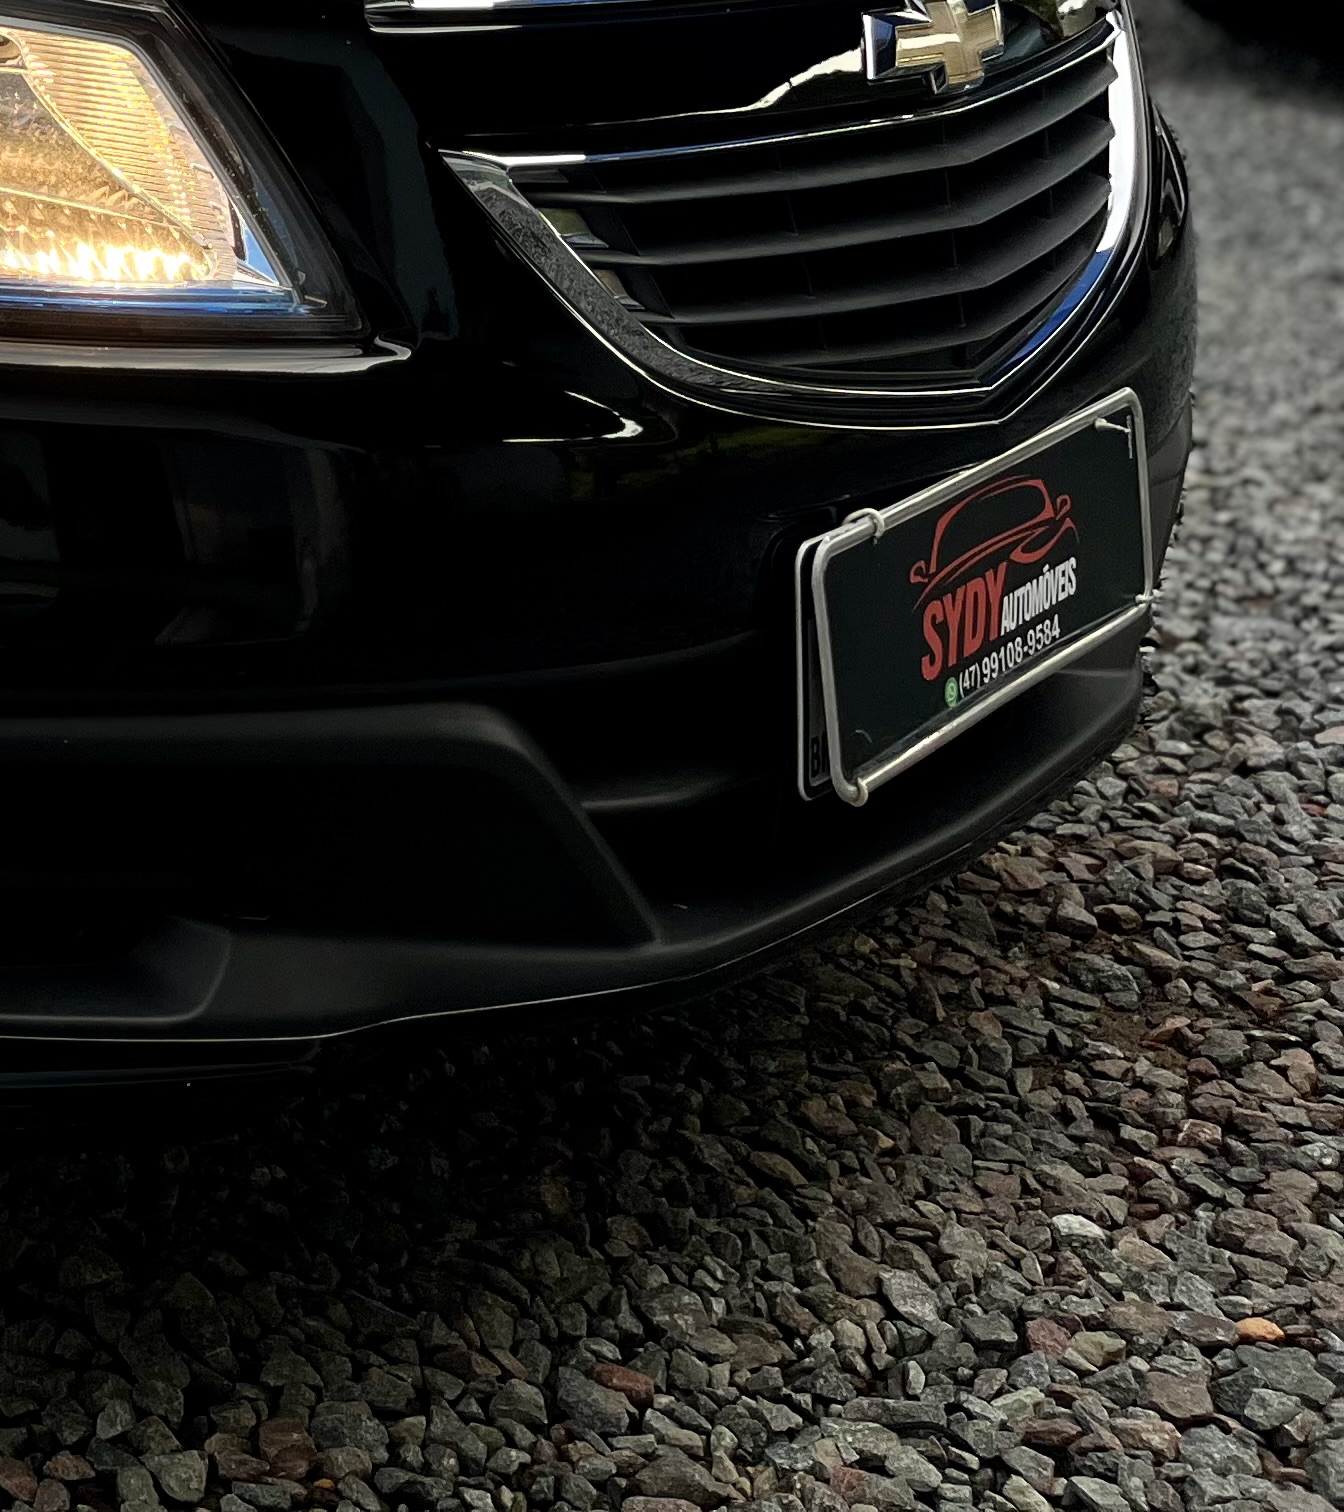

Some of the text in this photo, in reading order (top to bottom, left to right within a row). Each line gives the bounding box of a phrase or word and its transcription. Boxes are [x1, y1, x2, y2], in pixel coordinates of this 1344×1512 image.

[921, 556, 1077, 681] SYDY AUTOMÓVEIS
[959, 614, 1061, 698] (47) 99108-9584
